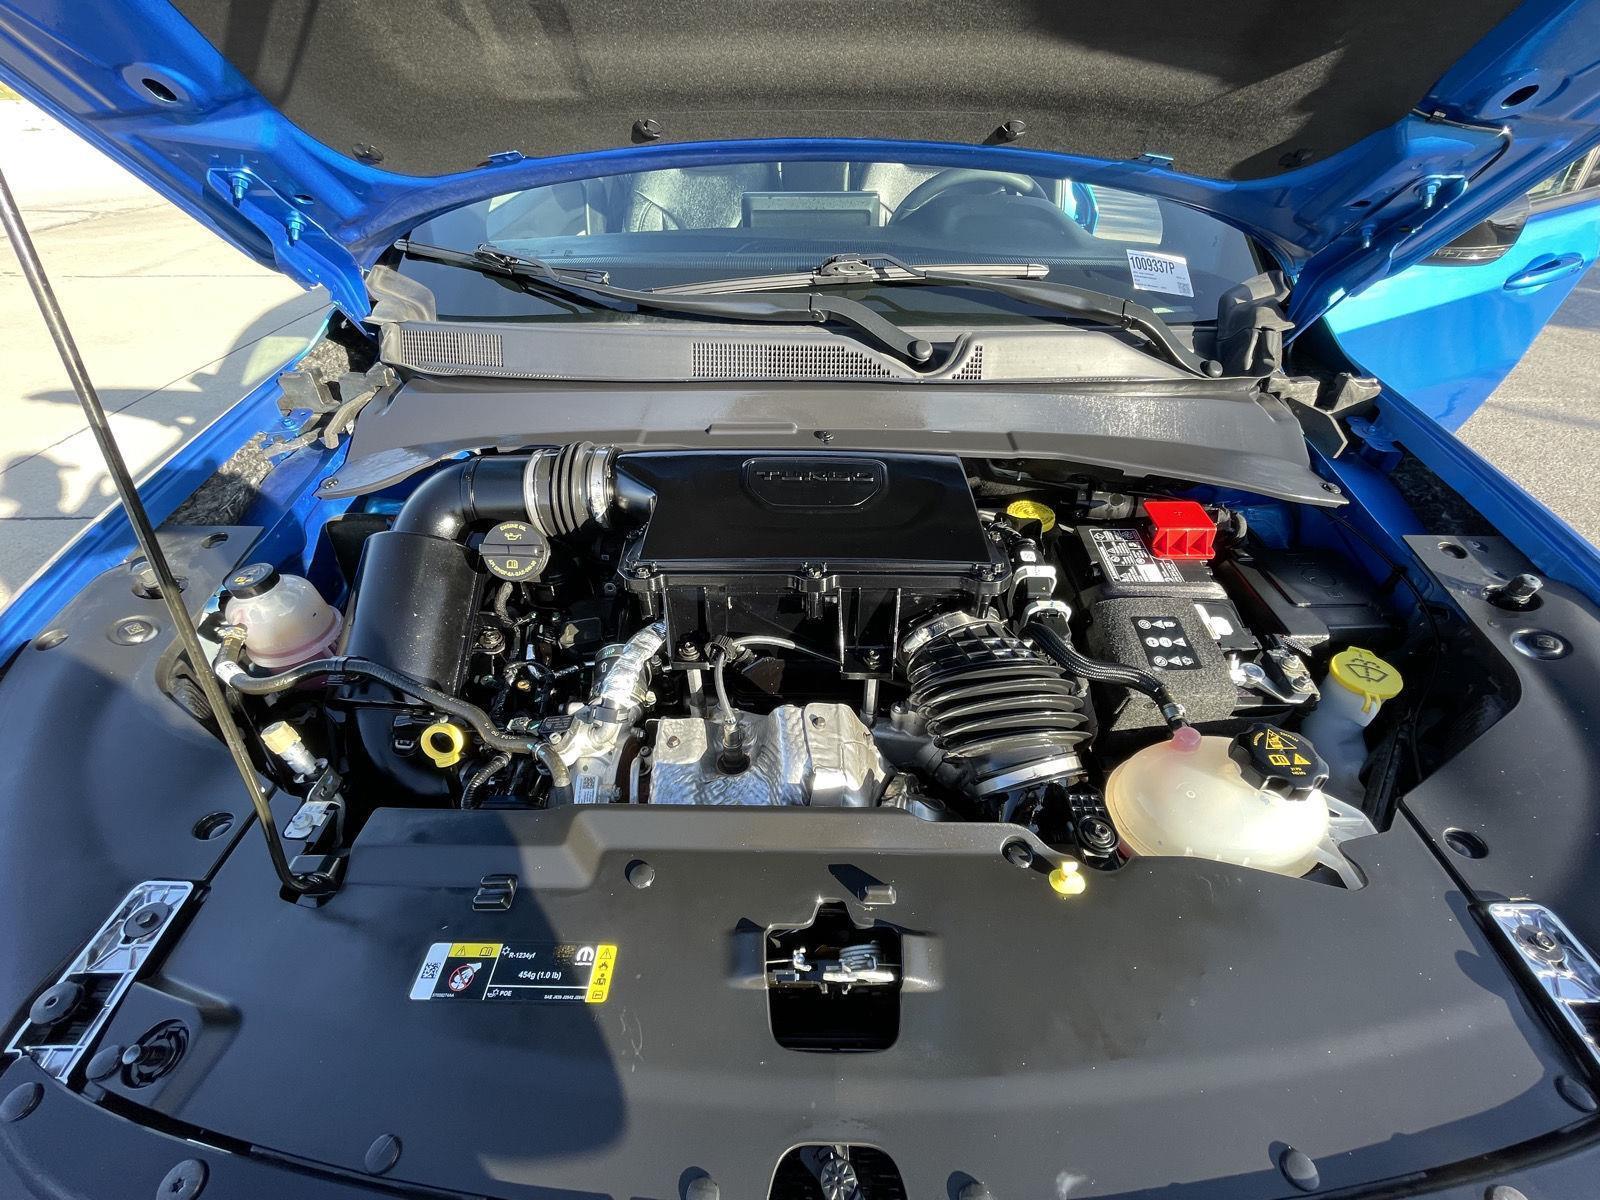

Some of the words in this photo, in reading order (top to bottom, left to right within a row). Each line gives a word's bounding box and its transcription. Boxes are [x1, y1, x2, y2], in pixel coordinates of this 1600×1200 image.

[1130, 256, 1174, 274] 1009337P
[508, 952, 537, 960] R-1234yf
[518, 970, 536, 980] 454g
[536, 971, 551, 980] (1.0
[551, 971, 562, 980] lb)
